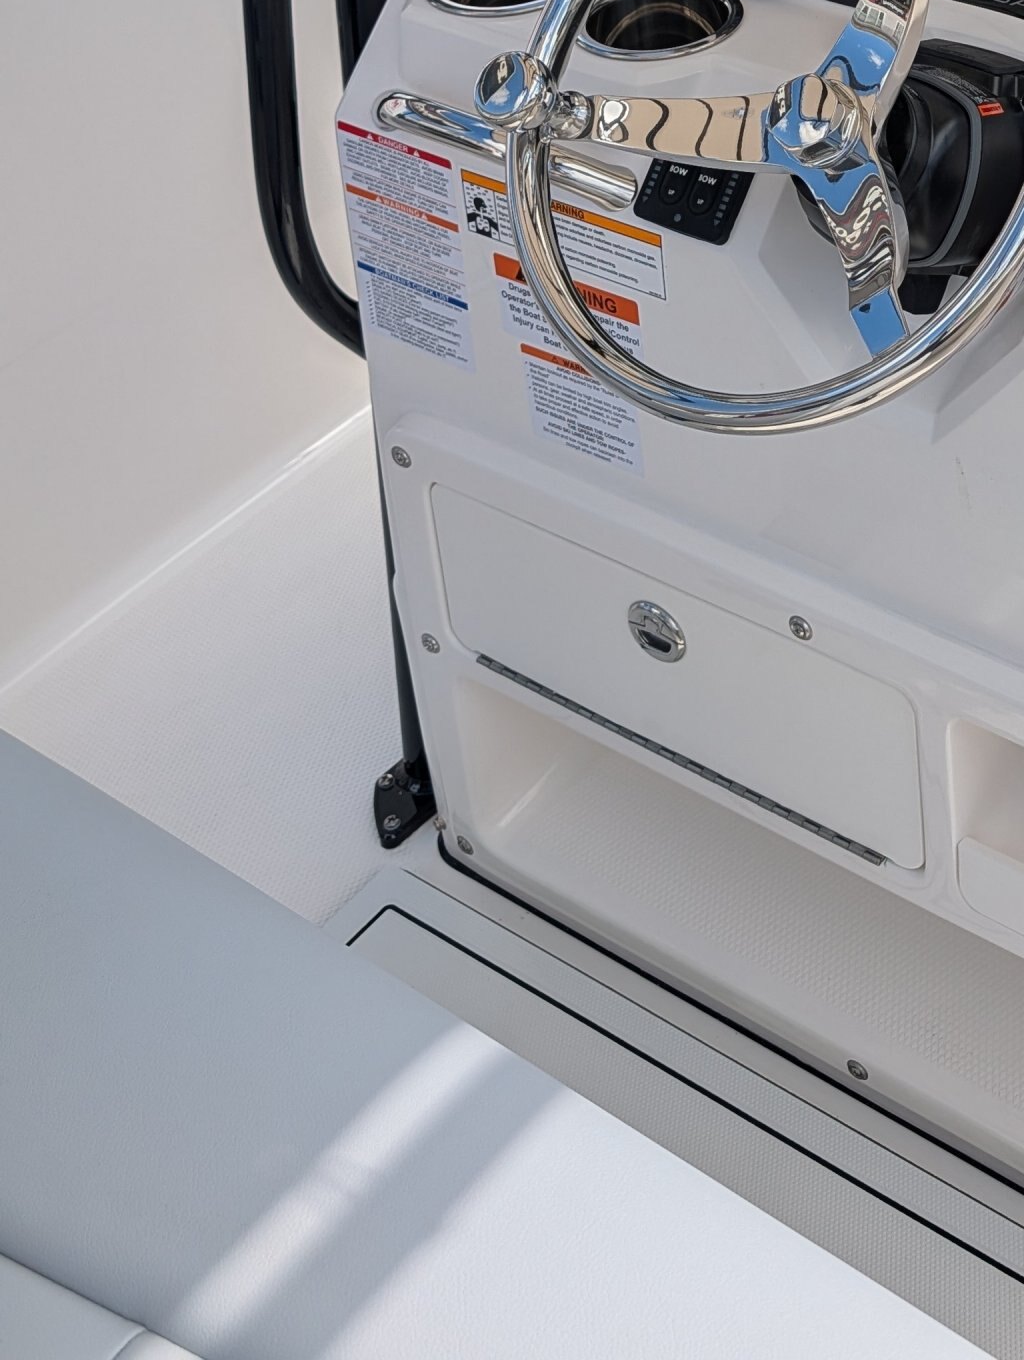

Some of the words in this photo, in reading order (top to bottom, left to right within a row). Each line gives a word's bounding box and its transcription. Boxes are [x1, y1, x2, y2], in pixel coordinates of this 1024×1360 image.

[377, 135, 408, 153] DANGER
[382, 197, 420, 218] WARNING
[549, 200, 585, 220] ARNING
[411, 281, 433, 296] CHECK
[434, 290, 449, 302] LIST
[507, 281, 531, 298] Drugs
[615, 320, 629, 332] the
[508, 302, 522, 314] the
[522, 307, 541, 321] Boat
[512, 313, 535, 329] Injury
[535, 323, 550, 334] can
[543, 335, 561, 348] Boat
